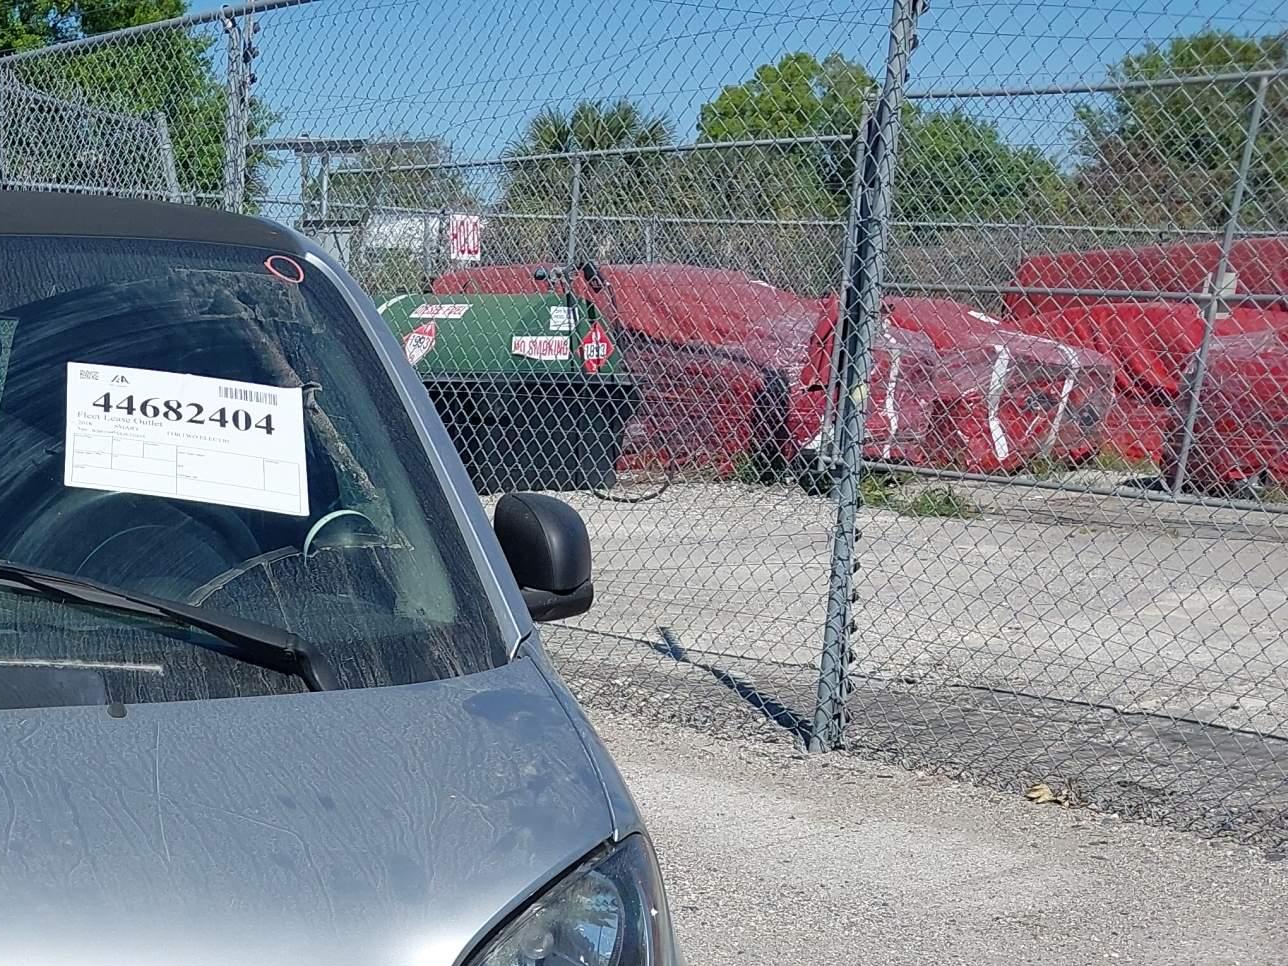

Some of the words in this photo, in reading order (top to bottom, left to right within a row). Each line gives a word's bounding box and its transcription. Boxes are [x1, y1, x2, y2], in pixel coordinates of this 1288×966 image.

[513, 340, 526, 353] NO
[528, 340, 569, 357] SMOKING
[77, 410, 100, 420] Fleet
[104, 414, 131, 424] Lease
[133, 417, 163, 427] Outlet
[93, 391, 275, 435] 44682404
